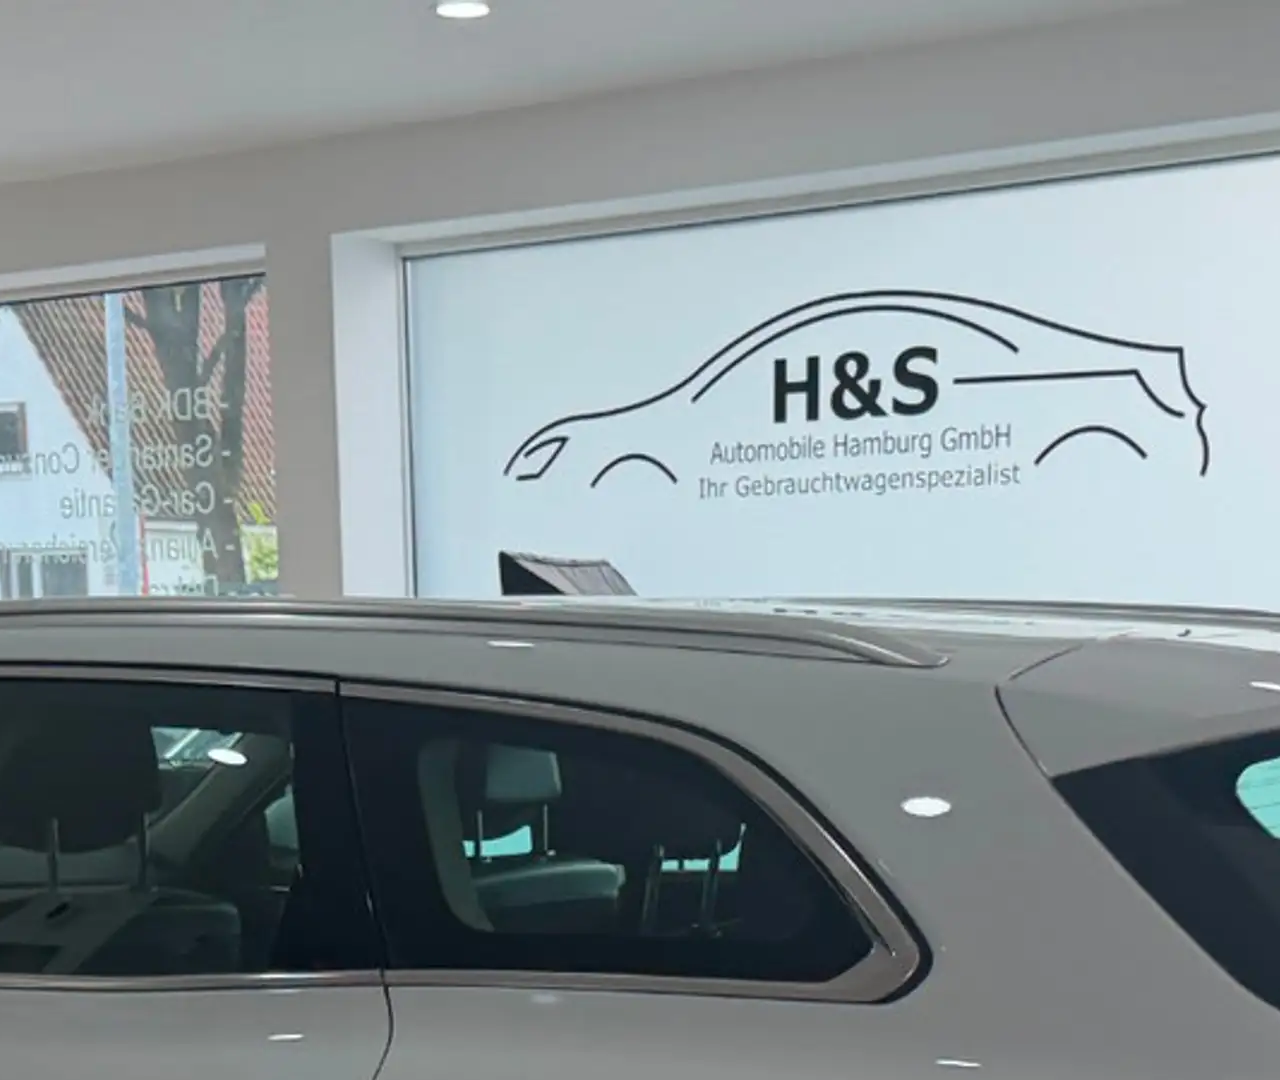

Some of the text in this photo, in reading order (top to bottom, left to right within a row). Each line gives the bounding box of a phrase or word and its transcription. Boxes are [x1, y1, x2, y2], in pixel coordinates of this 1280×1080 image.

[773, 346, 939, 423] H&S
[709, 423, 1012, 464] Automobile Hamburg GmbH
[698, 463, 1021, 500] Ihr Gebrauchtwagenspezialist
